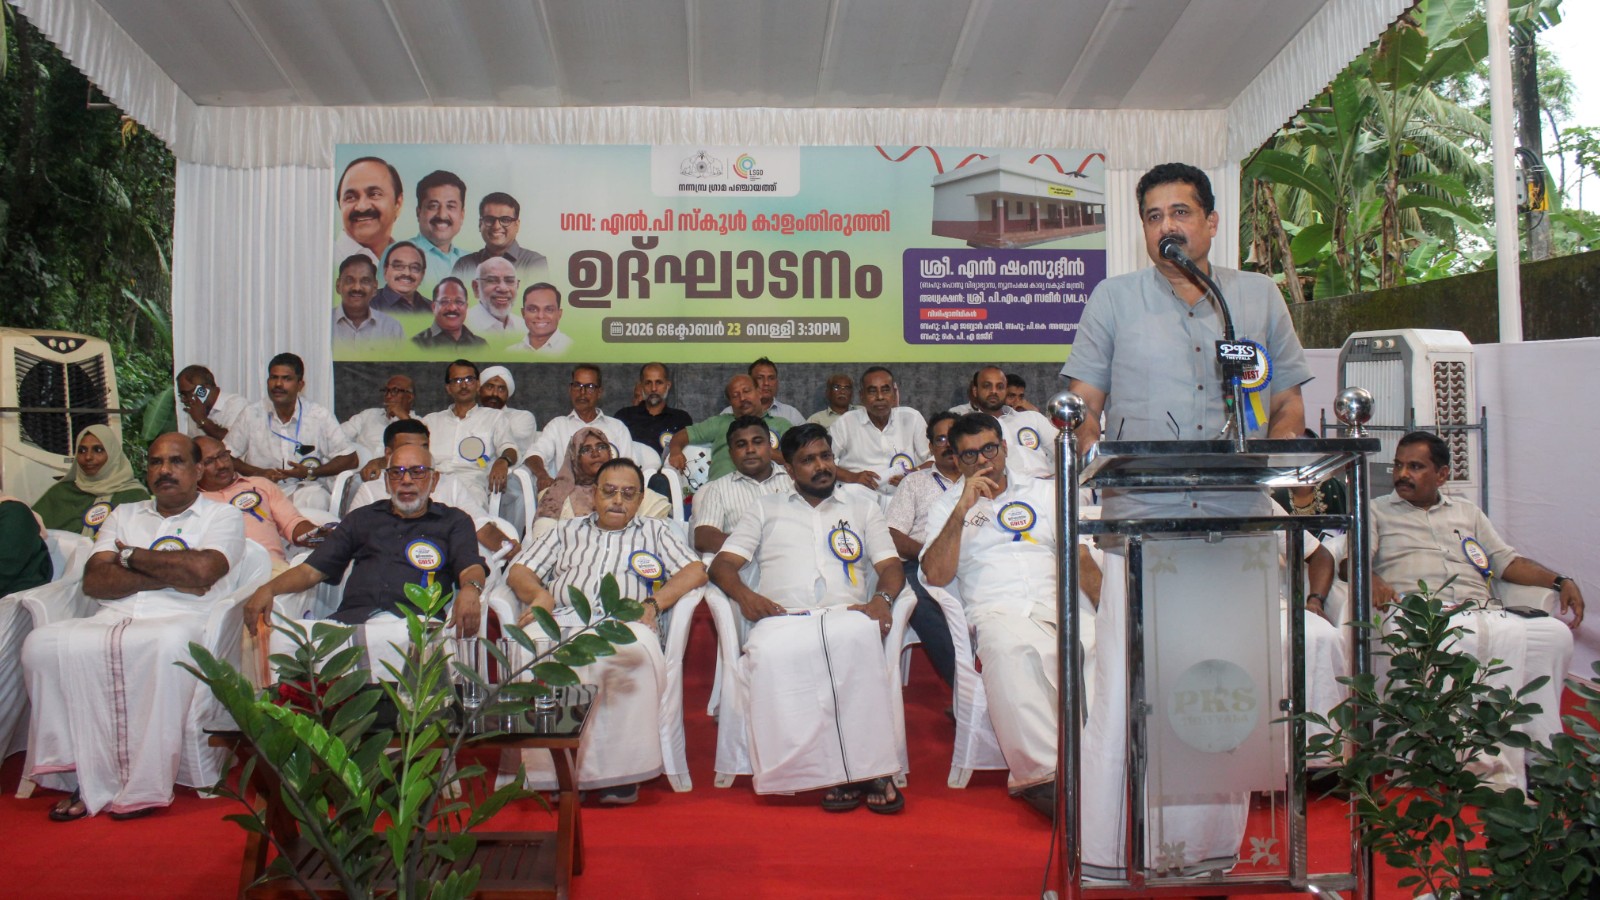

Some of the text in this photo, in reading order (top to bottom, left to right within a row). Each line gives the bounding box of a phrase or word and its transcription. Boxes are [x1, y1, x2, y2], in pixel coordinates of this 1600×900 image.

[708, 183, 727, 193] ഗ്രാമ
[560, 208, 891, 237] ഗവ: എൽ.പി സ്കൂൾ കാളംതിരുത്തി
[568, 235, 883, 309] ഉദ്ഘാടനം
[920, 255, 1084, 279] ശ്രീ. എൻ ഷംസുദ്ദീൻ
[1062, 293, 1088, 304] (MLA)
[625, 319, 841, 340] 2026 ഒക്ടോബർ 23 വെള്ളി 3:30PM
[1220, 344, 1255, 357] PKS
[1243, 370, 1259, 380] UEST
[1174, 687, 1256, 714] PKS
